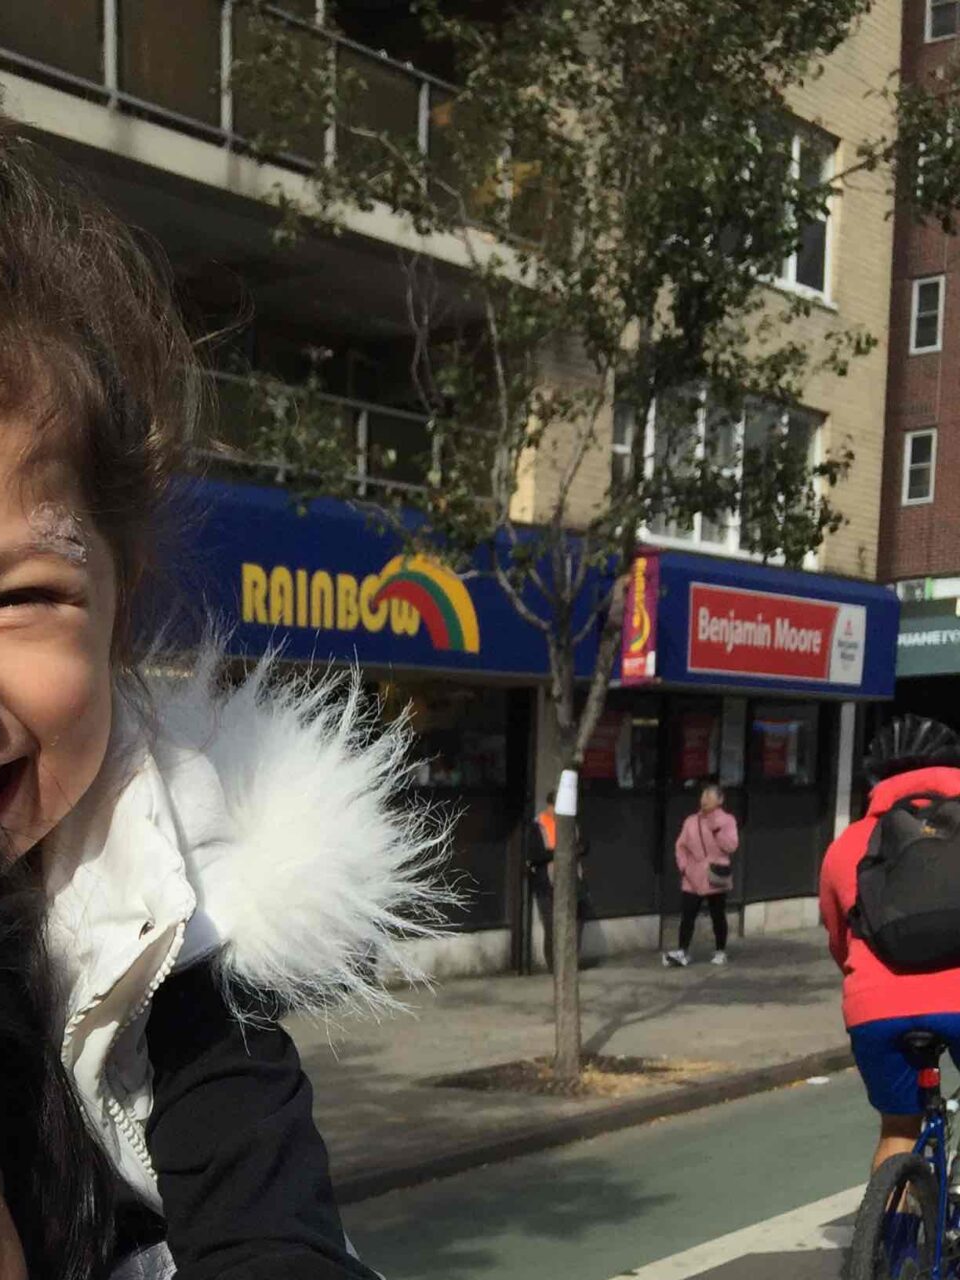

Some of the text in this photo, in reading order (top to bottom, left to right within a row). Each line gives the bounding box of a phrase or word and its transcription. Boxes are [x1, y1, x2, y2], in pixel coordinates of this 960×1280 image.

[242, 563, 421, 636] RAINBOW
[697, 606, 823, 654] Benjamin Moore
